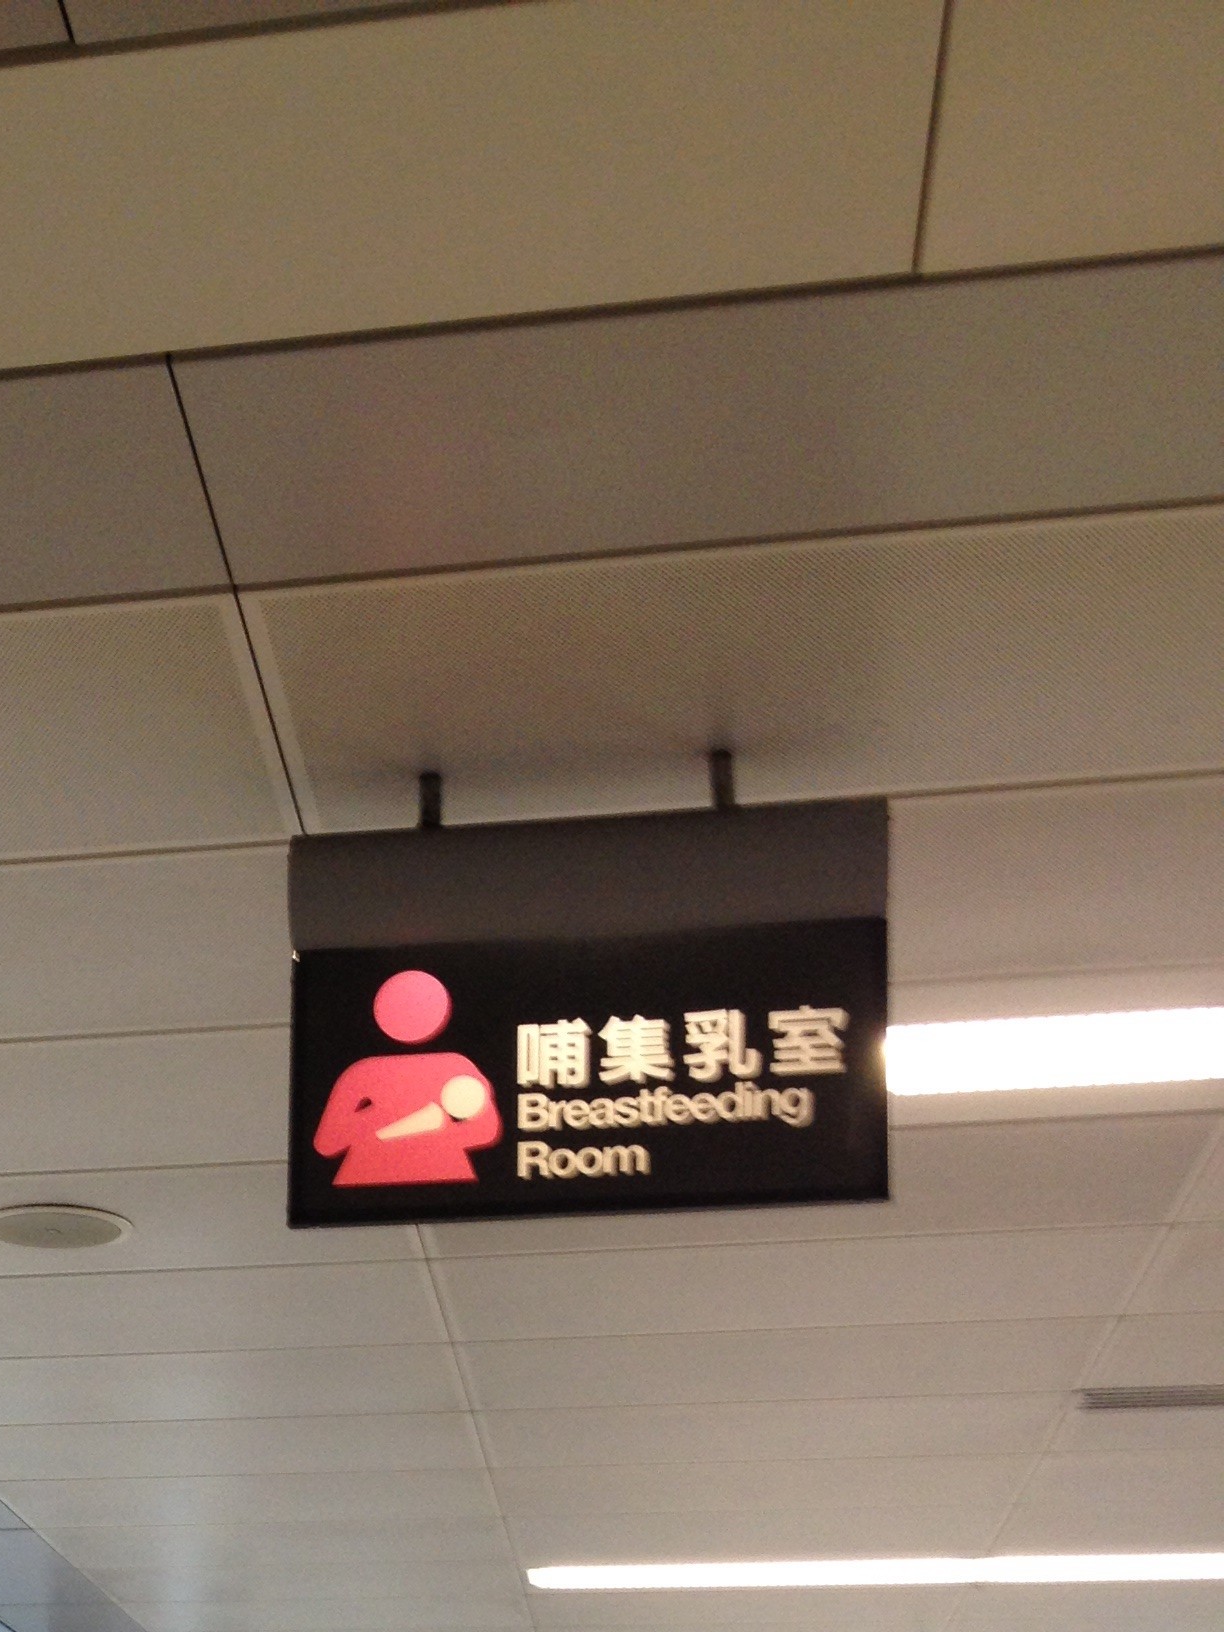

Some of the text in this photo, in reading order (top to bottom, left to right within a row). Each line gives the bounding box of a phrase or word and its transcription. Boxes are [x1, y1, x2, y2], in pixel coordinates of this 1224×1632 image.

[516, 1005, 850, 1089] 哺集乳室
[516, 1080, 815, 1133] Breastfeeding
[516, 1140, 652, 1180] Room
